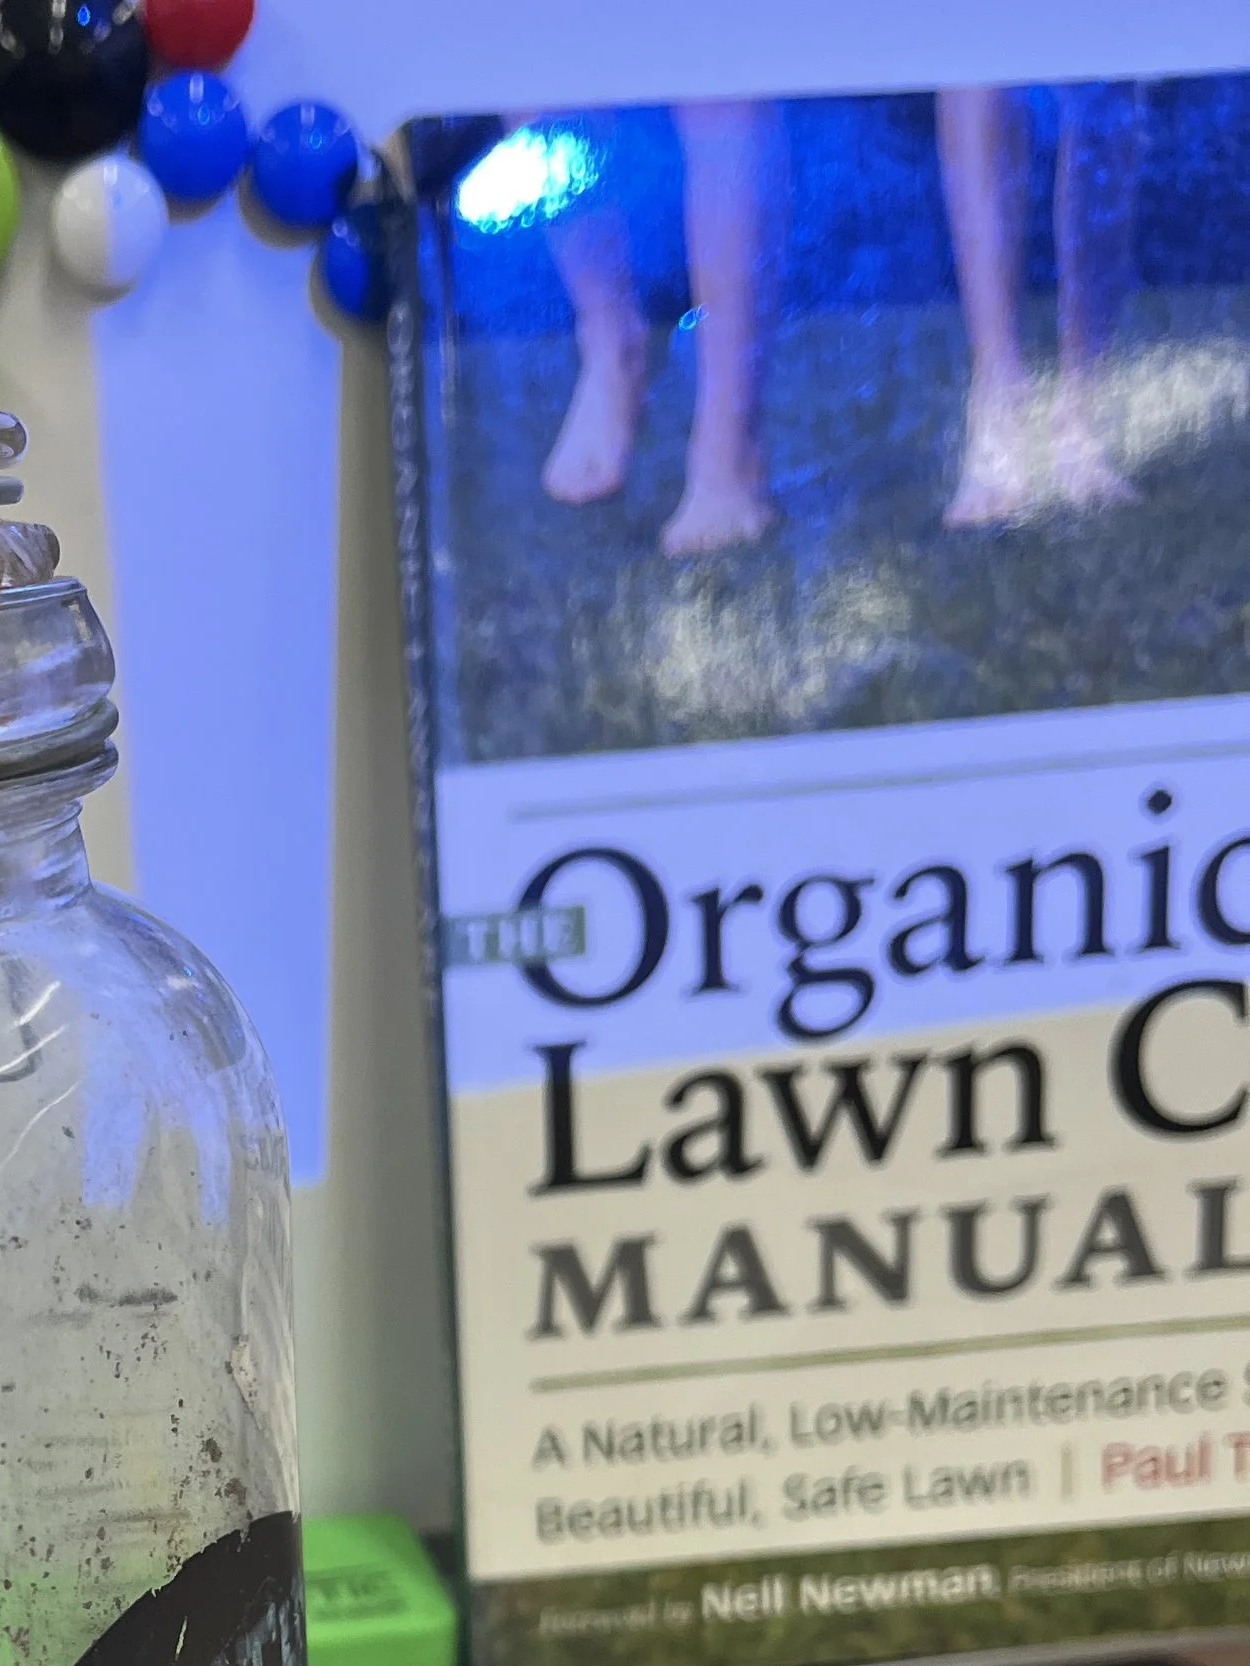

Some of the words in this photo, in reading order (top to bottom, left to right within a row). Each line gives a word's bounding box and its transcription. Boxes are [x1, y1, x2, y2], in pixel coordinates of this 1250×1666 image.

[454, 912, 576, 963] THE
[515, 788, 1250, 1045] Organic
[526, 1033, 1058, 1198] Lawn
[1108, 978, 1250, 1140] C
[525, 1176, 1250, 1342] MANUAL
[531, 1421, 568, 1471] A
[581, 1408, 773, 1465] Natural,
[787, 1365, 1228, 1447] Low-Maintenance
[534, 1475, 764, 1546] Beautiful,
[781, 1465, 888, 1523] Safe
[901, 1454, 1033, 1511] Lawn
[1100, 1430, 1213, 1494] Paul
[701, 1578, 785, 1625] Nell
